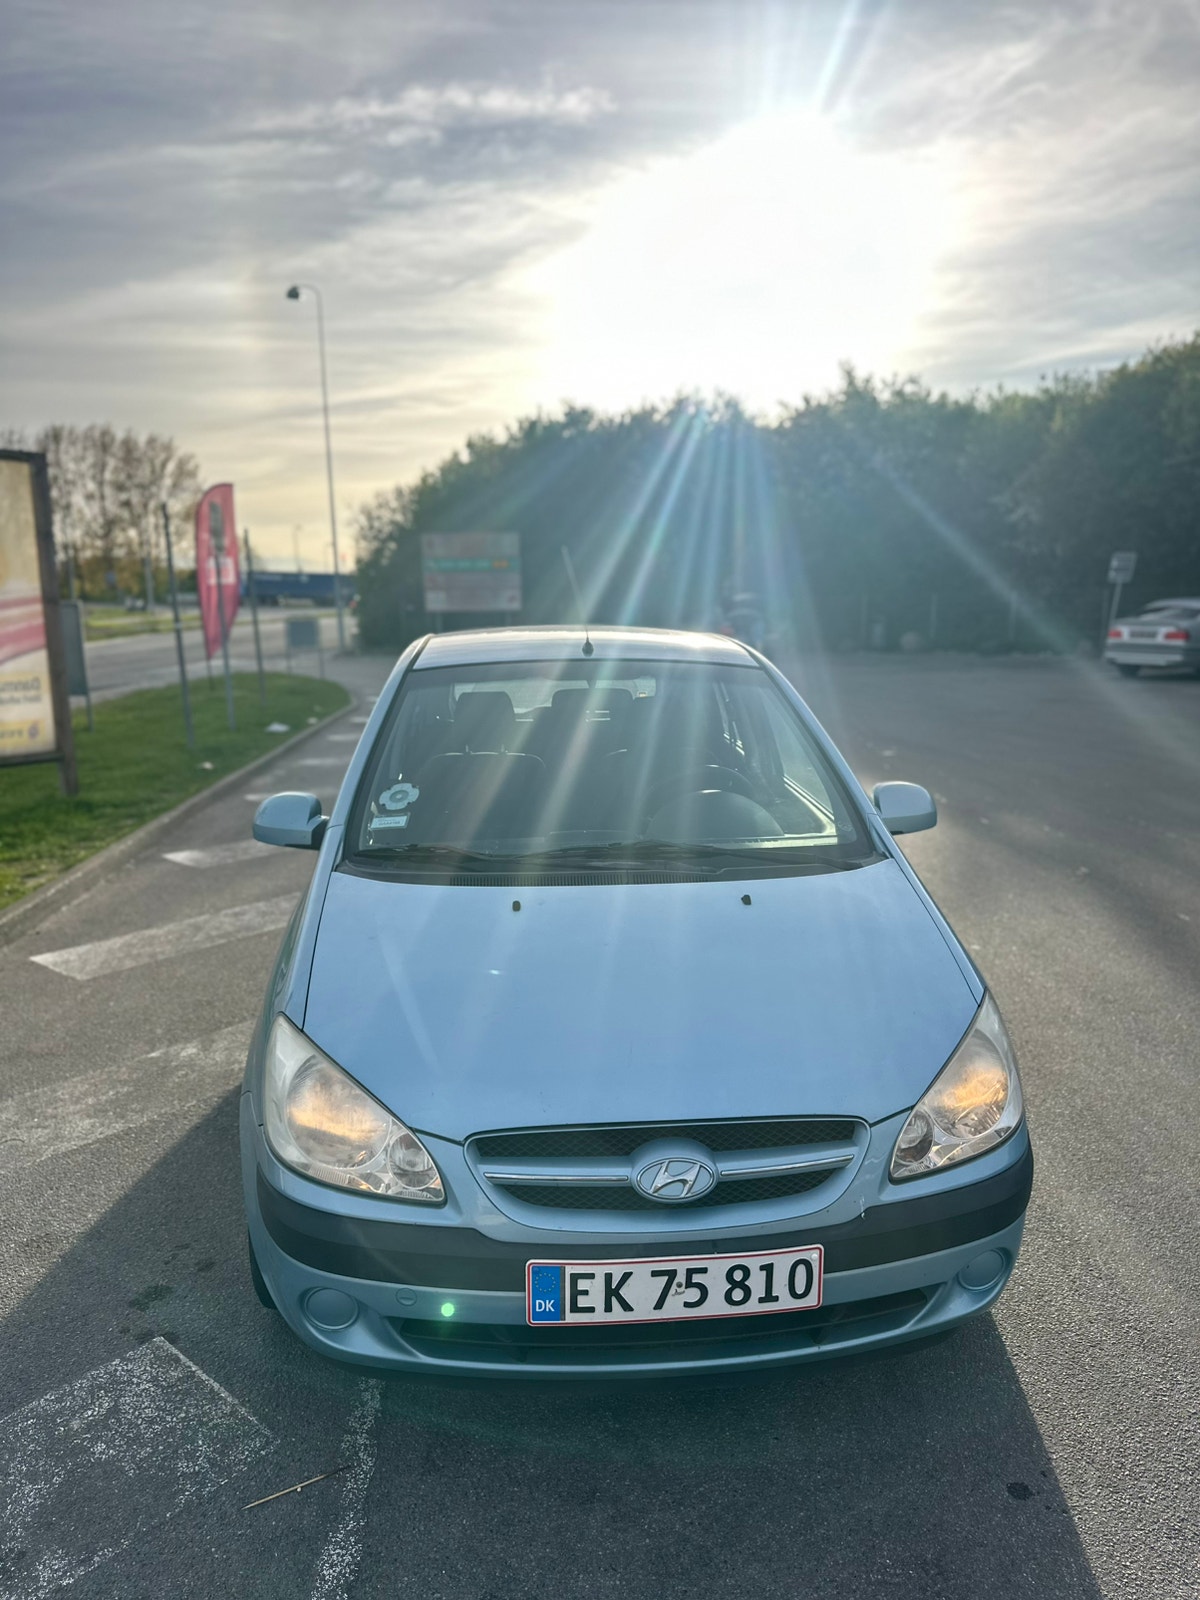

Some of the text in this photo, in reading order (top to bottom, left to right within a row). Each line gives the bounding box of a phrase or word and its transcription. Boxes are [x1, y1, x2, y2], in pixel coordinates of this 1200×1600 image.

[569, 1258, 814, 1314] EK 75 810
[535, 1299, 555, 1313] DK
